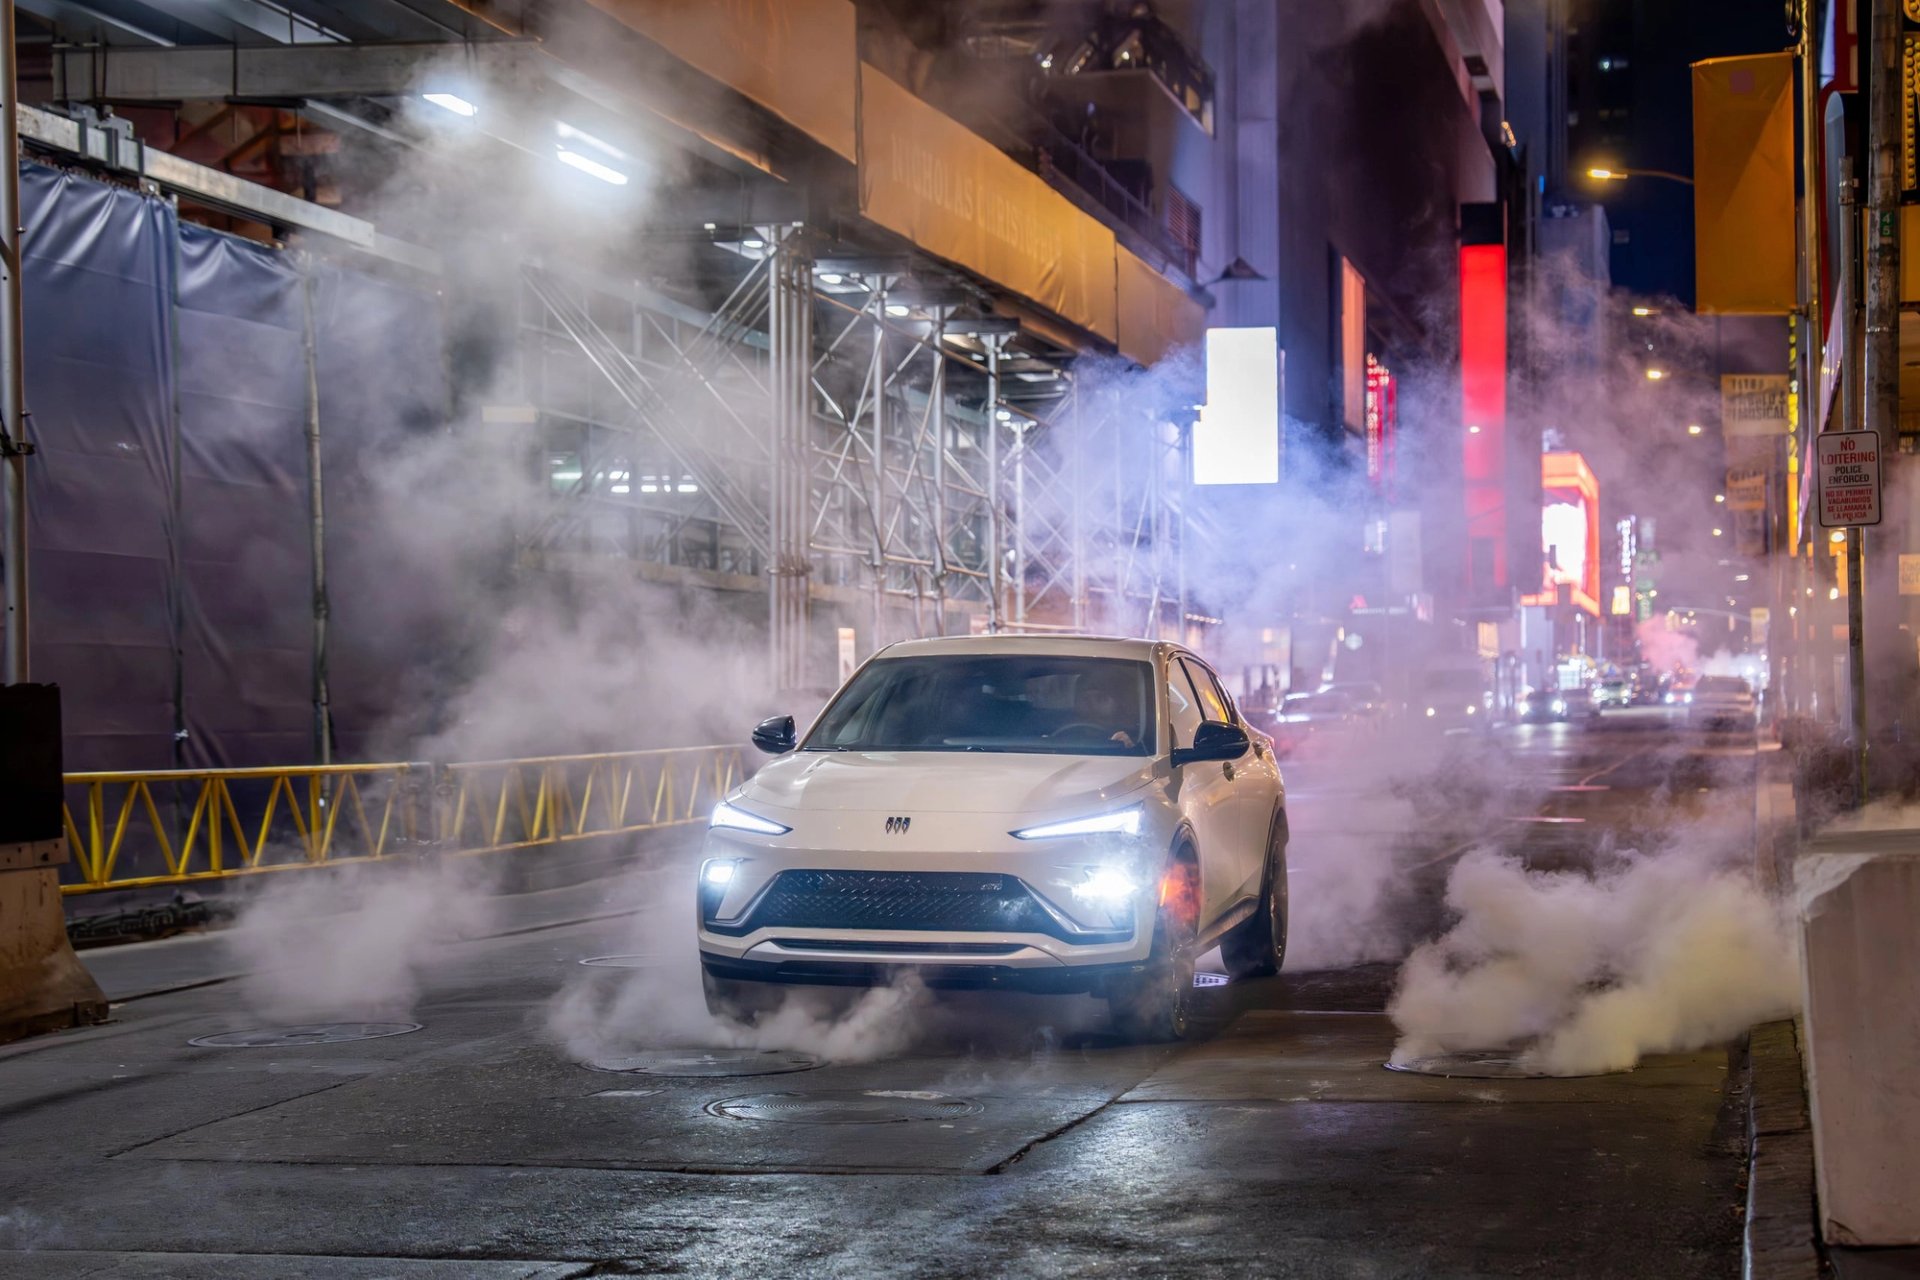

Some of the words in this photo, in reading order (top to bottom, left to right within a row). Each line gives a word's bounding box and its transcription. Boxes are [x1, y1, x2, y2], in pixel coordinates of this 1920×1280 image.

[891, 132, 973, 221] NICHOLAS
[1840, 440, 1855, 450] NO
[1821, 451, 1875, 465] LOITERING
[1835, 465, 1862, 474] POLICE
[1829, 474, 1869, 484] ENFORCED
[1845, 488, 1872, 496] PERMITE
[1832, 512, 1841, 520] LA
